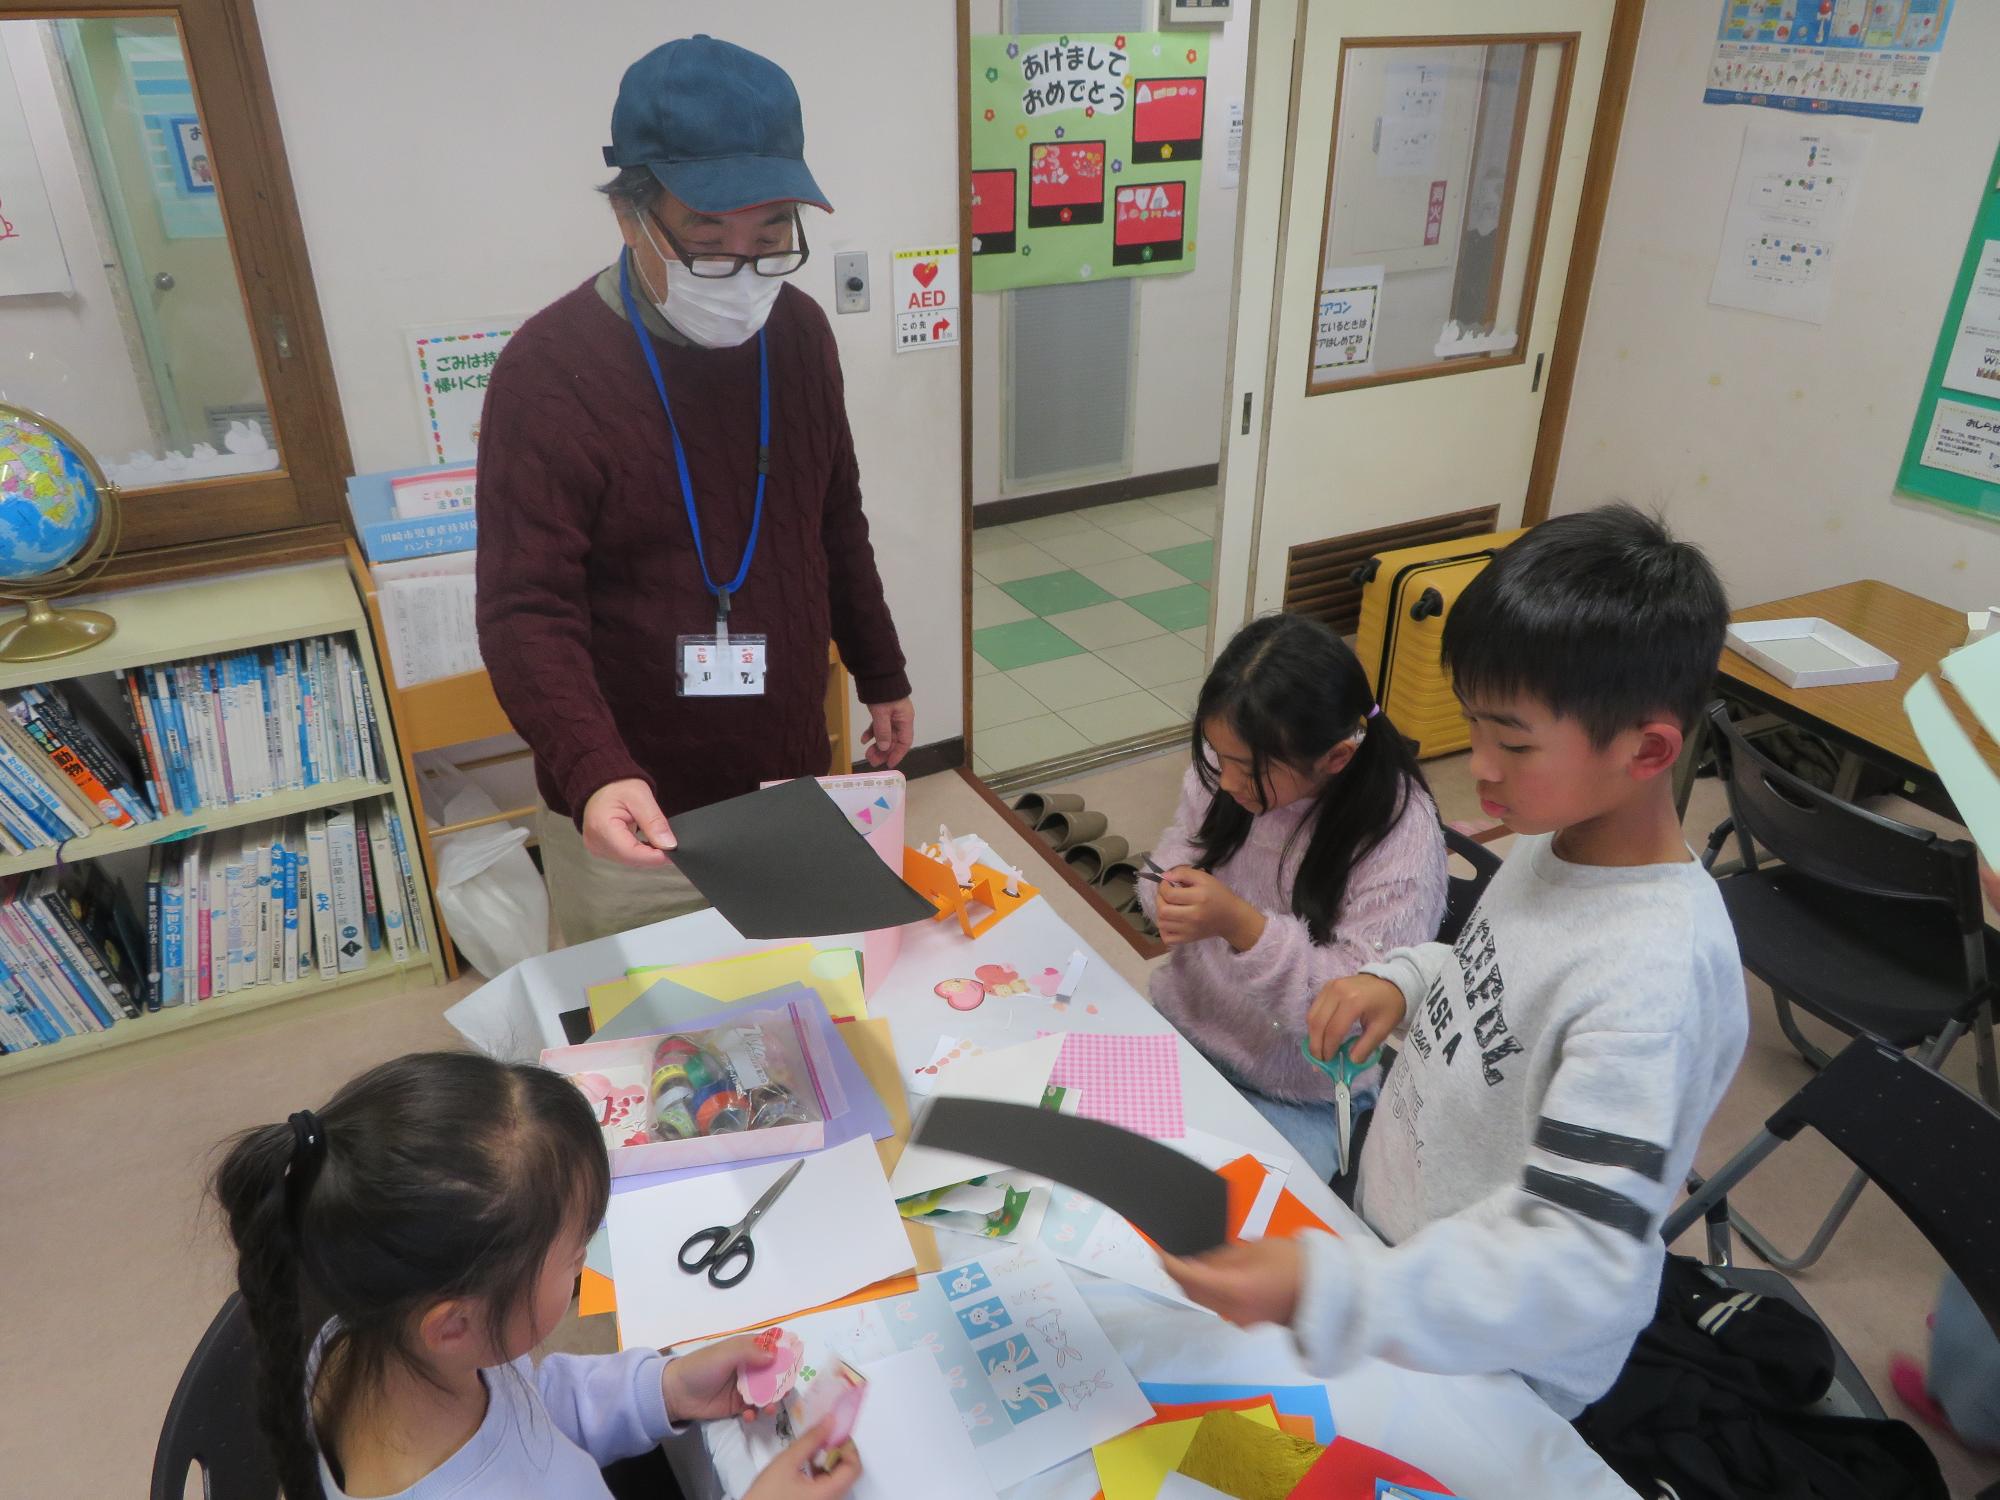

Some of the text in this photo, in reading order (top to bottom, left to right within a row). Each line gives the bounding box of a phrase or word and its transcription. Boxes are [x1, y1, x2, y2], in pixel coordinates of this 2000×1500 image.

[1022, 46, 1127, 80] あけまして
[1022, 80, 1126, 115] おめでとう
[908, 290, 945, 309] AED
